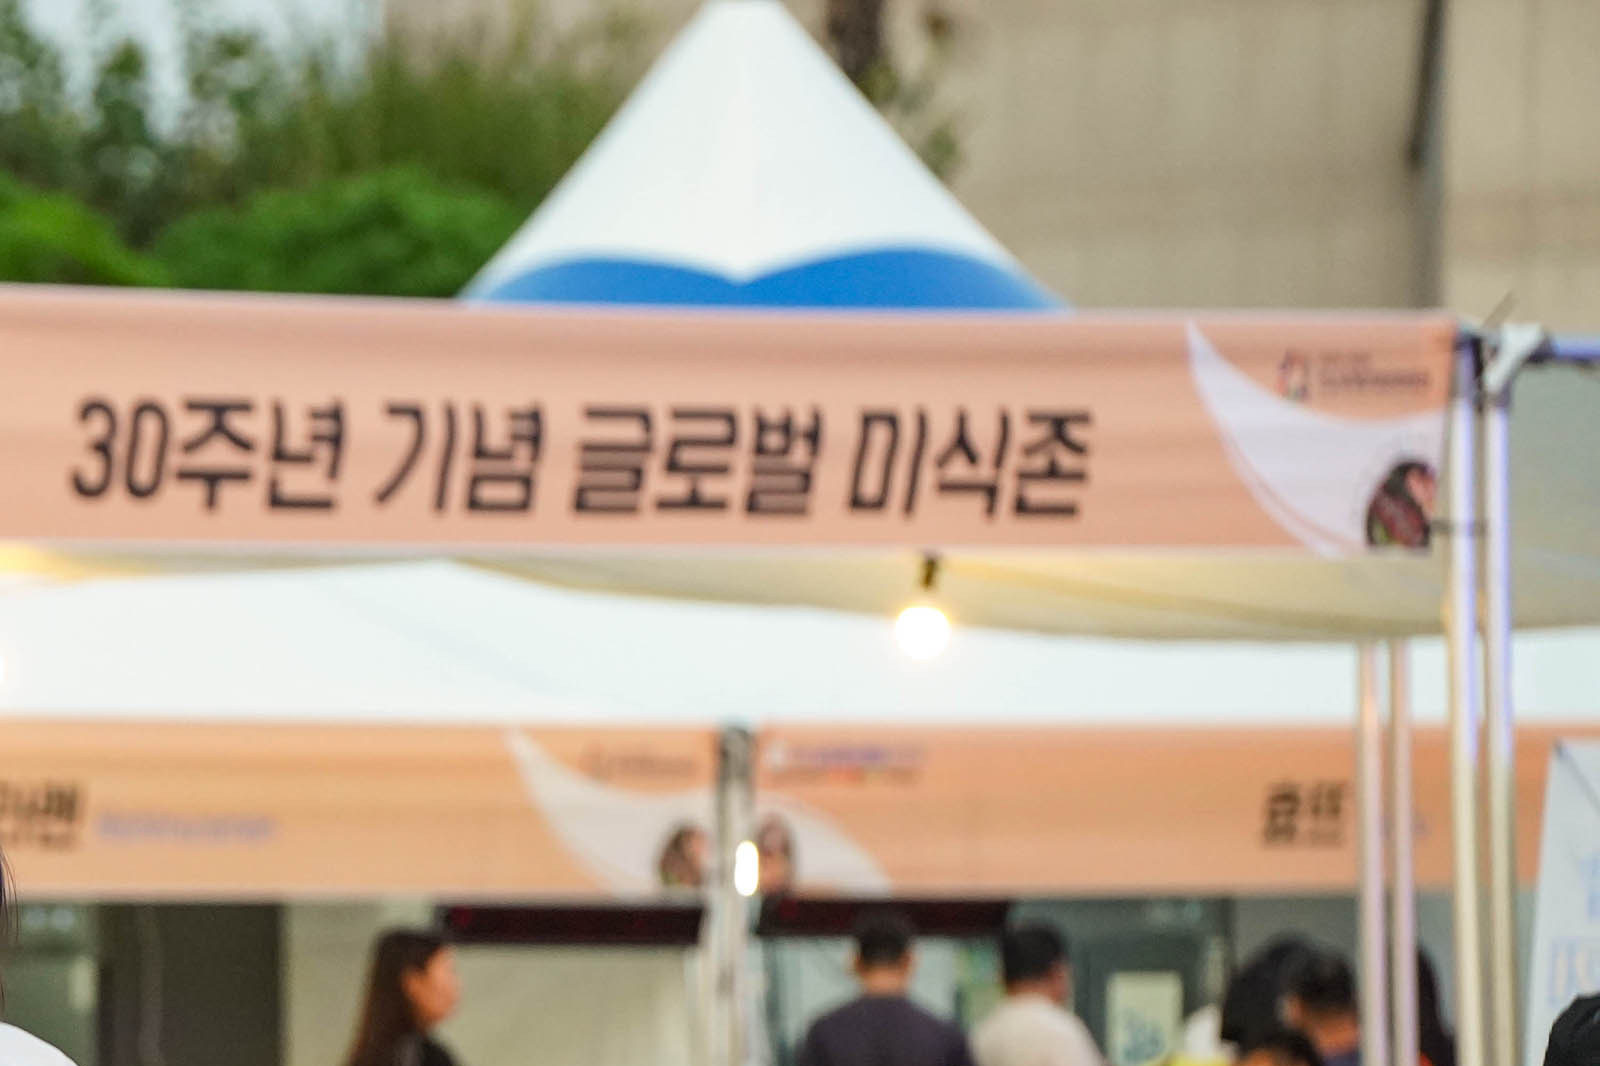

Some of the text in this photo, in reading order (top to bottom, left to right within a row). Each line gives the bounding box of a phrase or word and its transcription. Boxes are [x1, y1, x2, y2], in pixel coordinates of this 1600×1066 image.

[72, 393, 1092, 518] 30주년 기념 글로벌 미식존
